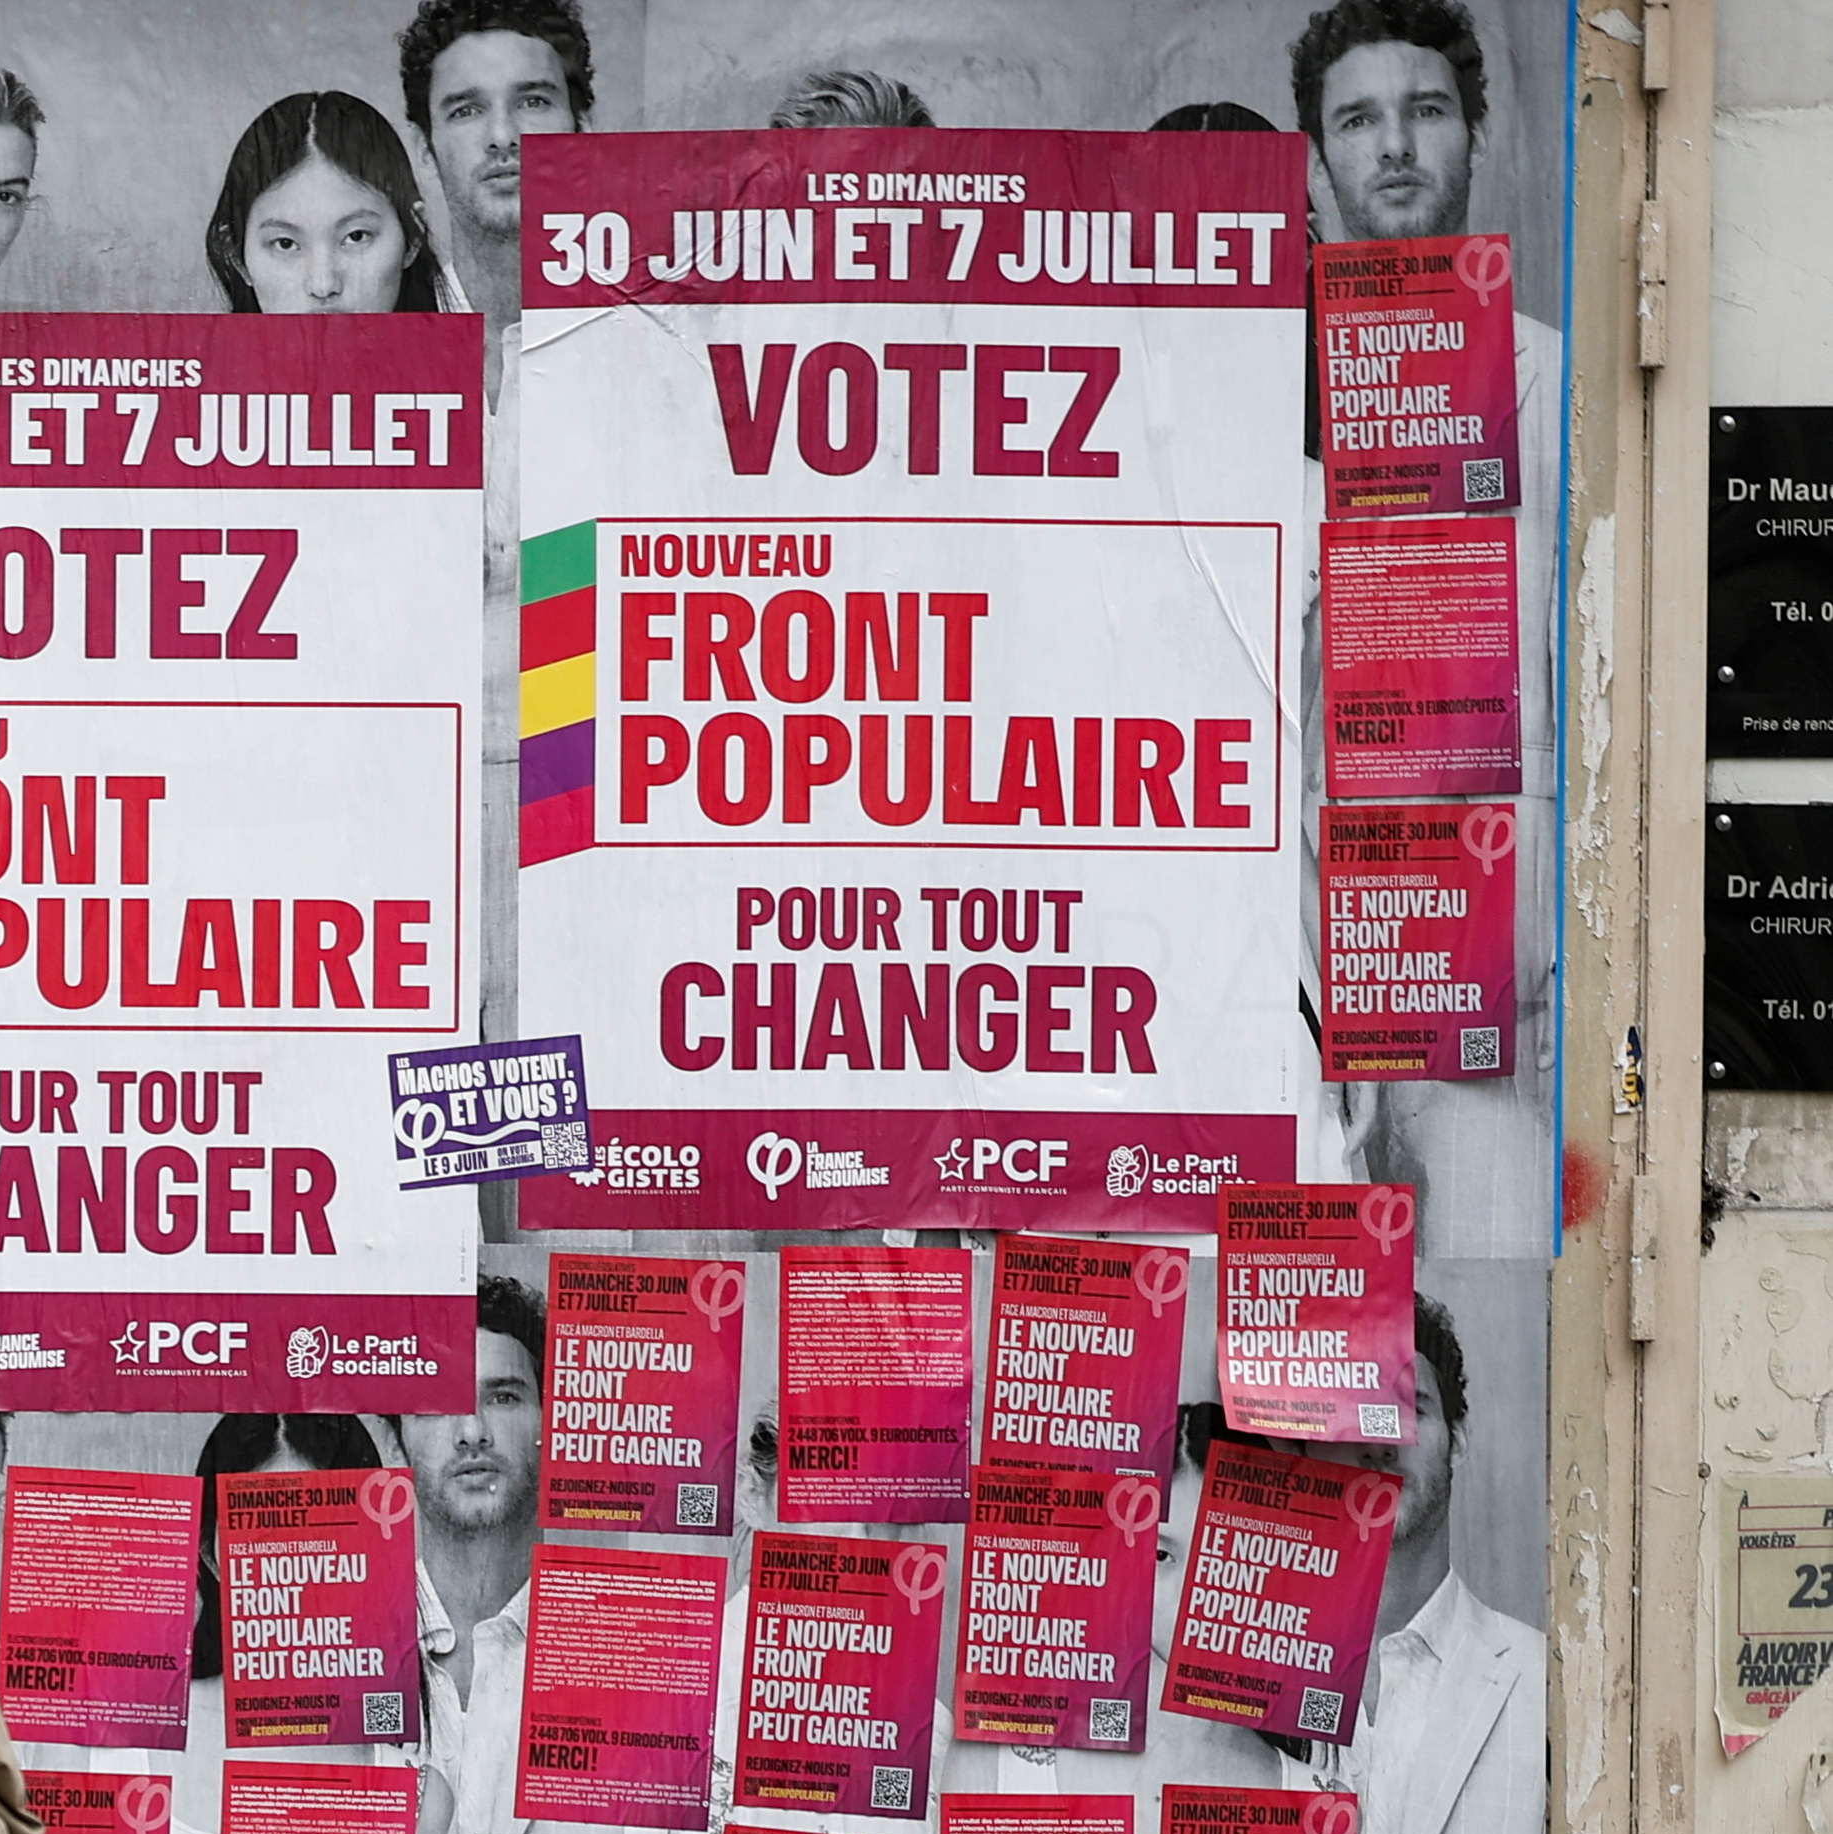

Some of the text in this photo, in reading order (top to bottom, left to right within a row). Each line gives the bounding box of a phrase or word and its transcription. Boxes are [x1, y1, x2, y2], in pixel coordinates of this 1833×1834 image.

[808, 172, 1025, 204] LES DIMANCHES
[541, 209, 1286, 286] 30 JUIN ET 7 JUILLET
[43, 358, 202, 388] DIMANCHES
[707, 341, 1121, 478] VOTEZ
[11, 393, 98, 466] ET
[116, 393, 159, 466] 7
[175, 393, 463, 466] JUILLET
[1728, 478, 1760, 502] Dr
[621, 534, 832, 578] NOUVEAU
[1771, 602, 1813, 622] Tél.
[620, 589, 989, 704] FRONT
[619, 712, 1252, 828] POPULAIRE
[1728, 875, 1760, 898] Dr
[736, 887, 1083, 953] POUR TOUT
[661, 961, 1157, 1074] CHANGER
[97, 1071, 262, 1136] TOUT
[1227, 1269, 1364, 1297] LE NOUVEAU
[1227, 1299, 1300, 1327] FRONT
[1228, 1331, 1348, 1357] POPULAIRE
[1228, 1360, 1380, 1389] PEUT GAGNER
[1740, 1531, 1795, 1548] VOUS ÊTES
[1738, 1665, 1815, 1687] FRANCE
